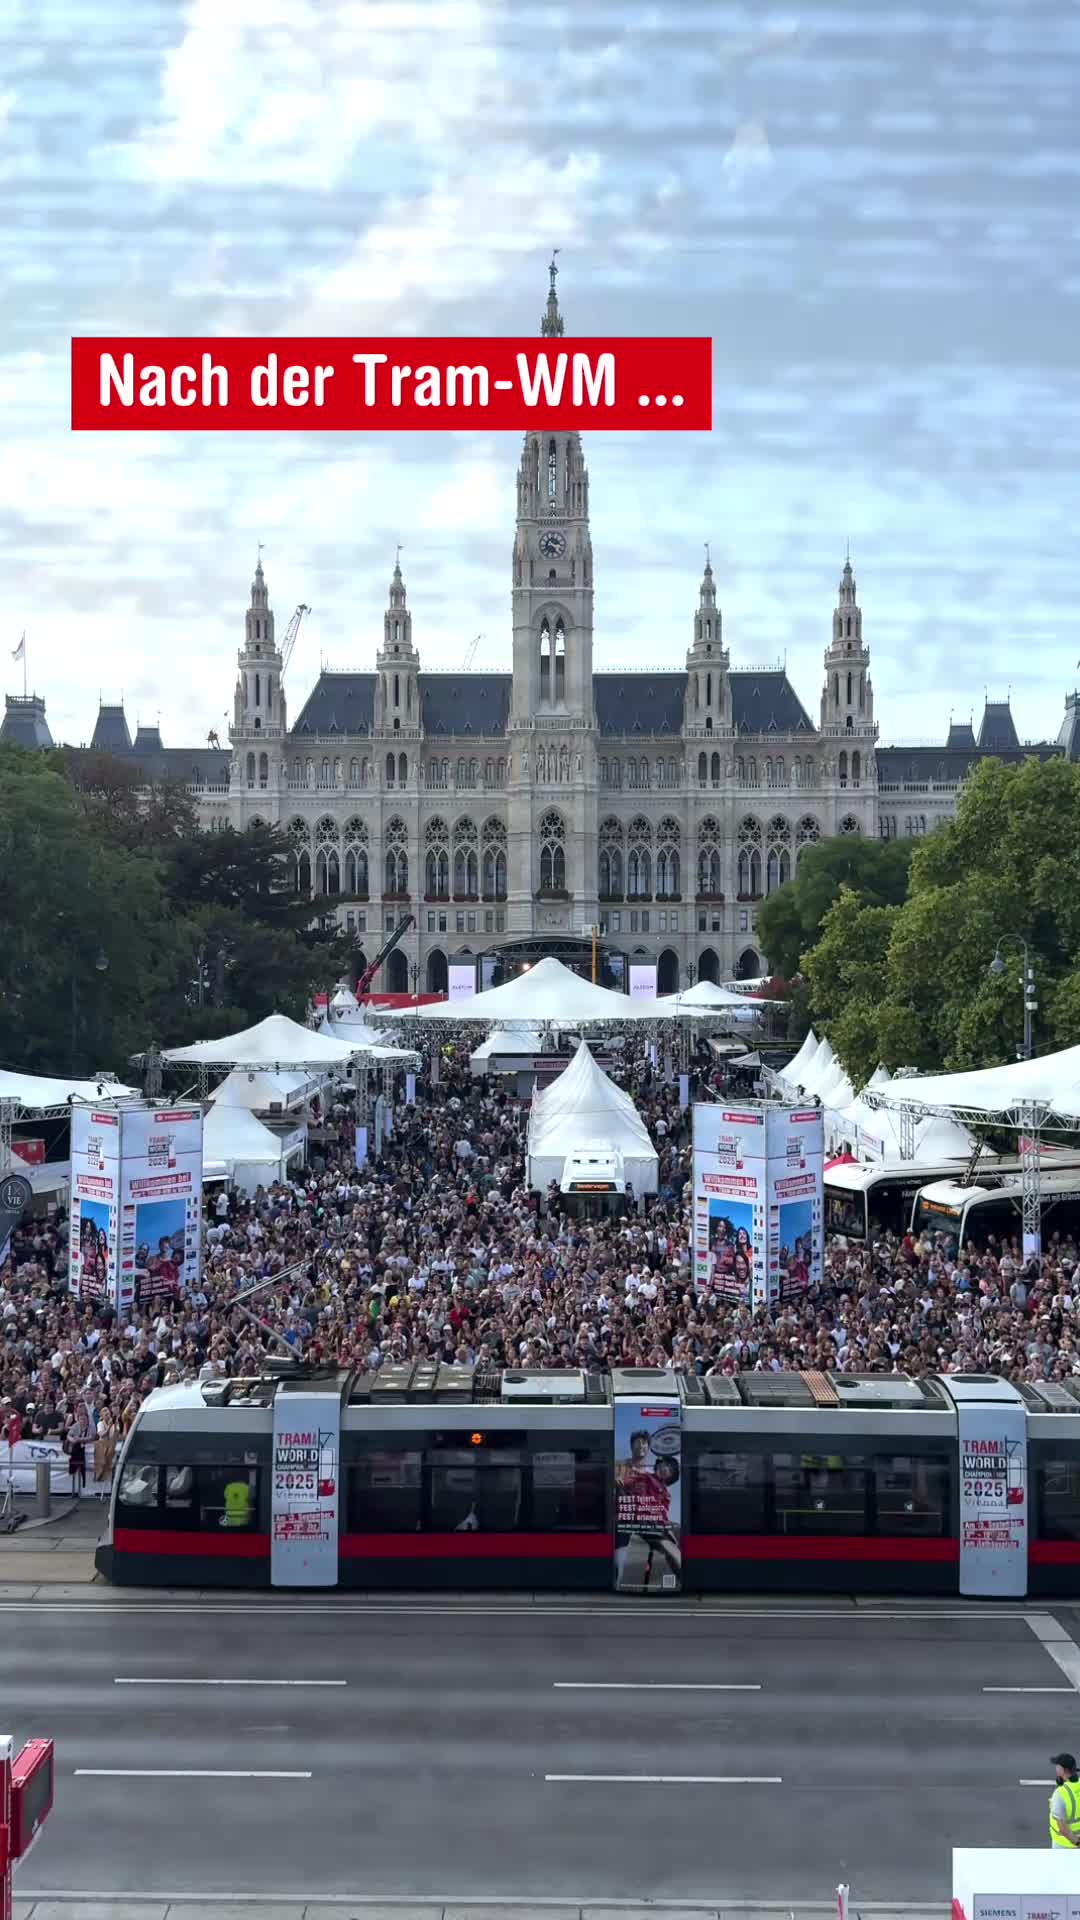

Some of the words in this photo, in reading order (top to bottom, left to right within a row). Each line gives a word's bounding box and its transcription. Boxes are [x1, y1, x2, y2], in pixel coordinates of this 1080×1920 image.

[131, 1176, 176, 1190] Willkommen
[177, 1172, 191, 1182] bei
[703, 1174, 744, 1186] Willkommen
[277, 1433, 312, 1446] TRAM
[963, 1440, 998, 1454] TRAM
[277, 1449, 318, 1462] WORLD
[964, 1457, 1006, 1469] WORLD
[275, 1474, 314, 1490] 2025
[964, 1481, 1003, 1497] 2025
[980, 1909, 1016, 1917] SIEMENS
